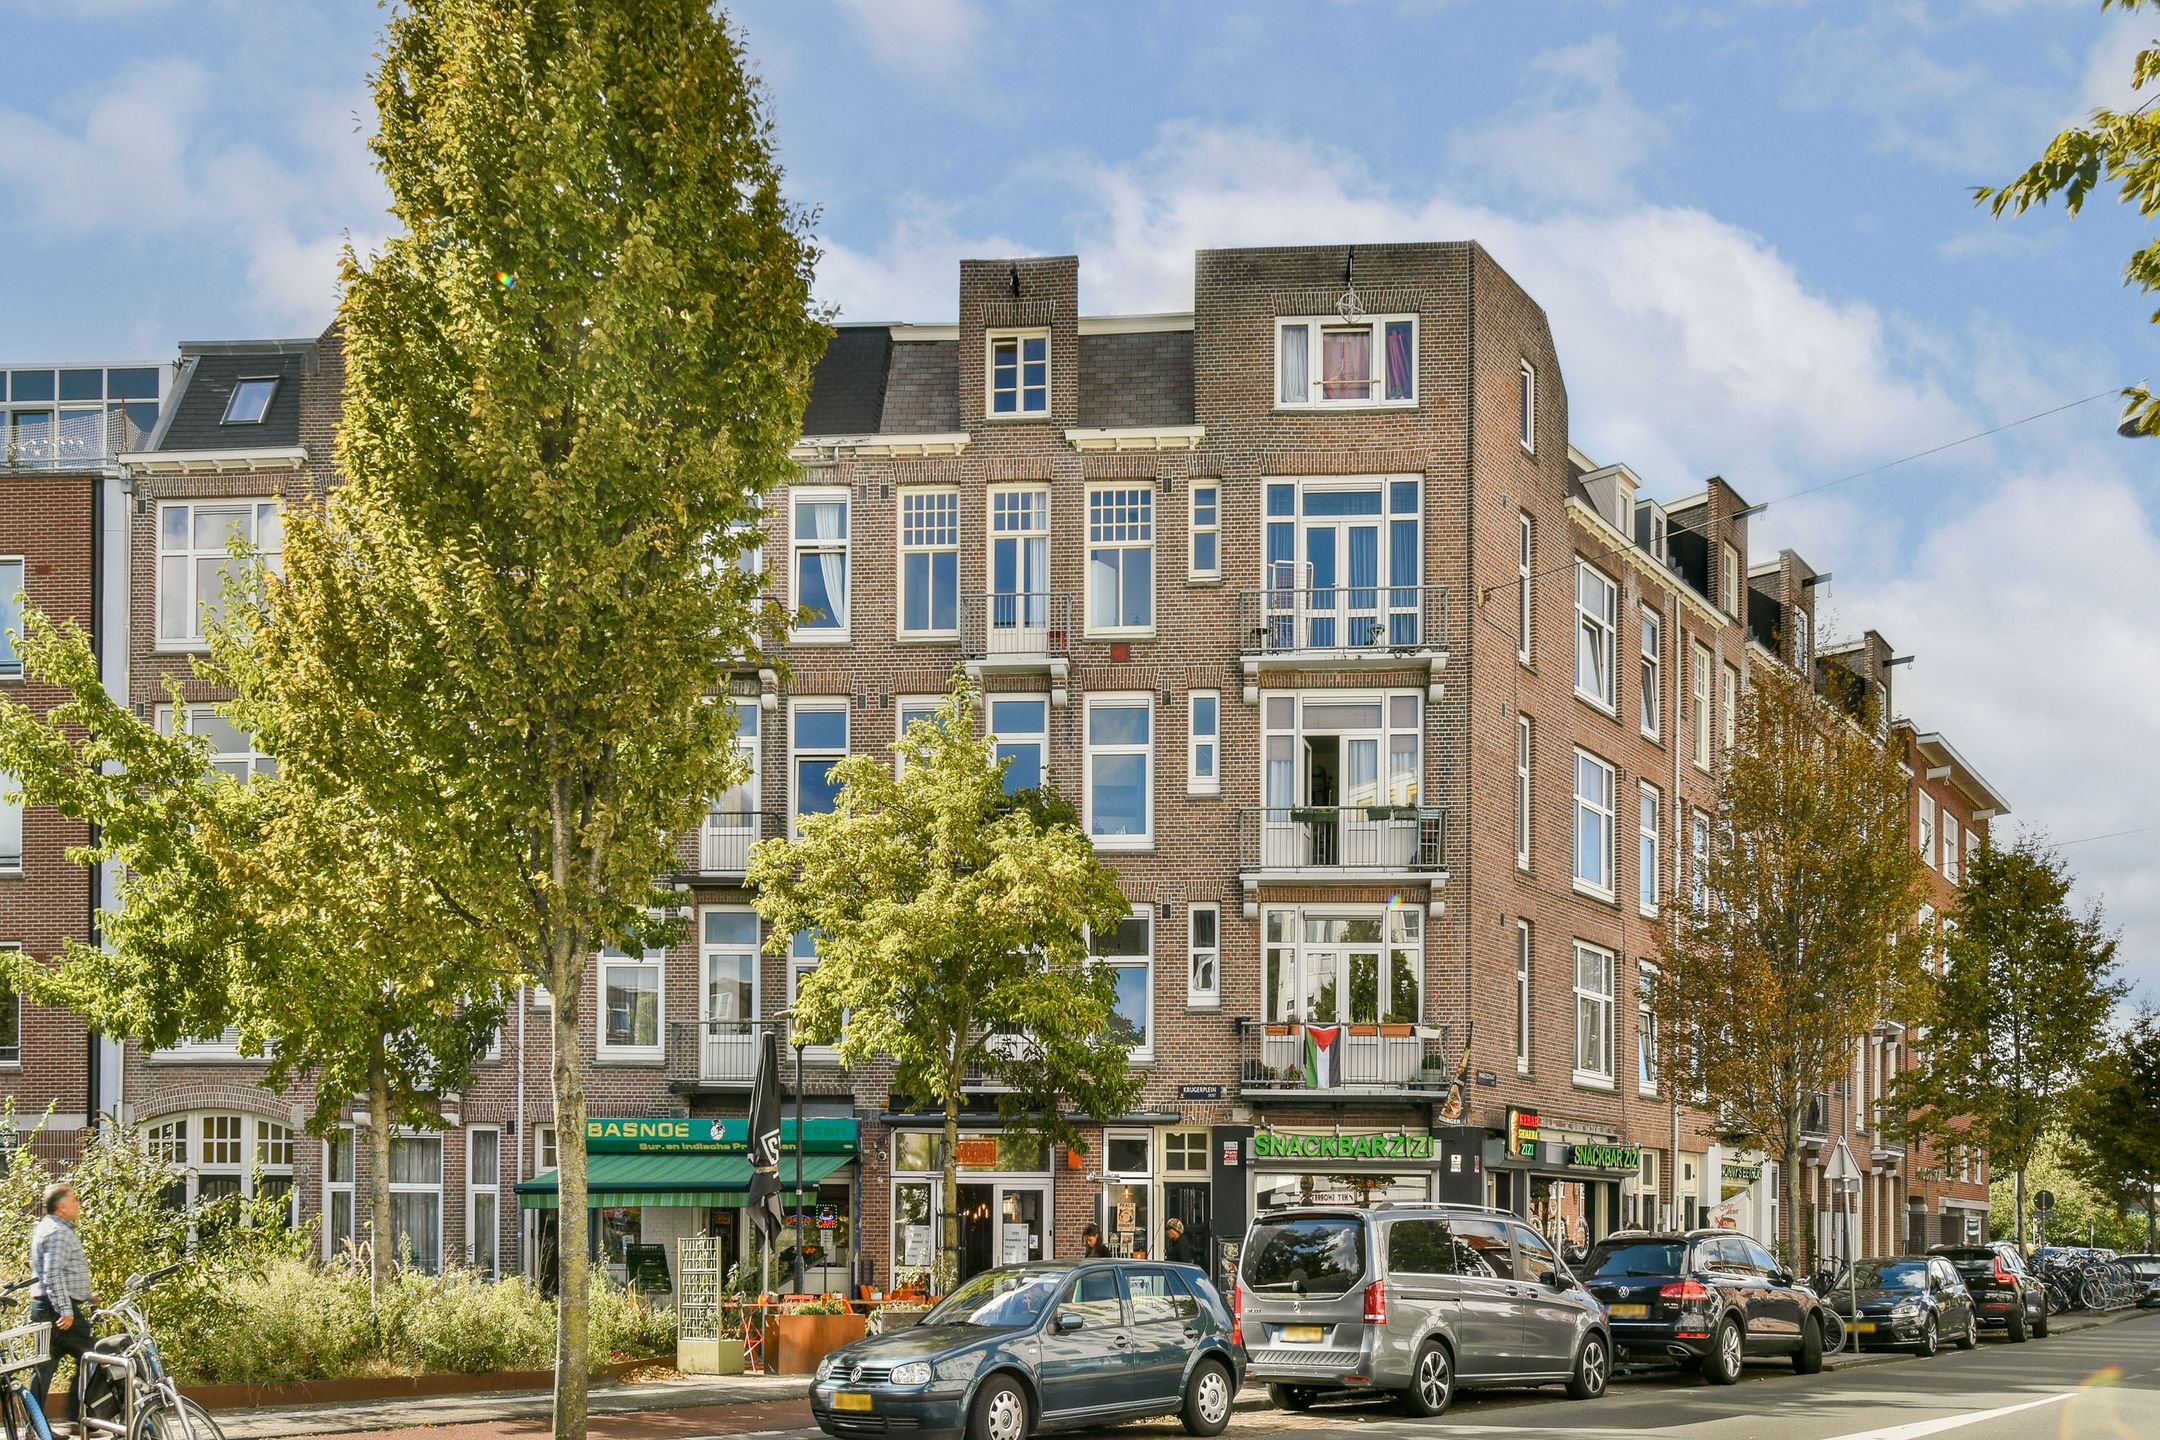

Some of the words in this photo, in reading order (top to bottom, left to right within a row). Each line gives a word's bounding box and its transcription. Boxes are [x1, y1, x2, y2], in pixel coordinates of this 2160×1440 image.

[1519, 1114, 1540, 1127] KEBAB
[587, 1122, 689, 1138] BASNOE
[1255, 1135, 1388, 1157] SNACKBAR
[1390, 1136, 1434, 1157] ZIZI
[1521, 1143, 1534, 1156] ZIZI
[1574, 1145, 1623, 1168] SNACKBAR
